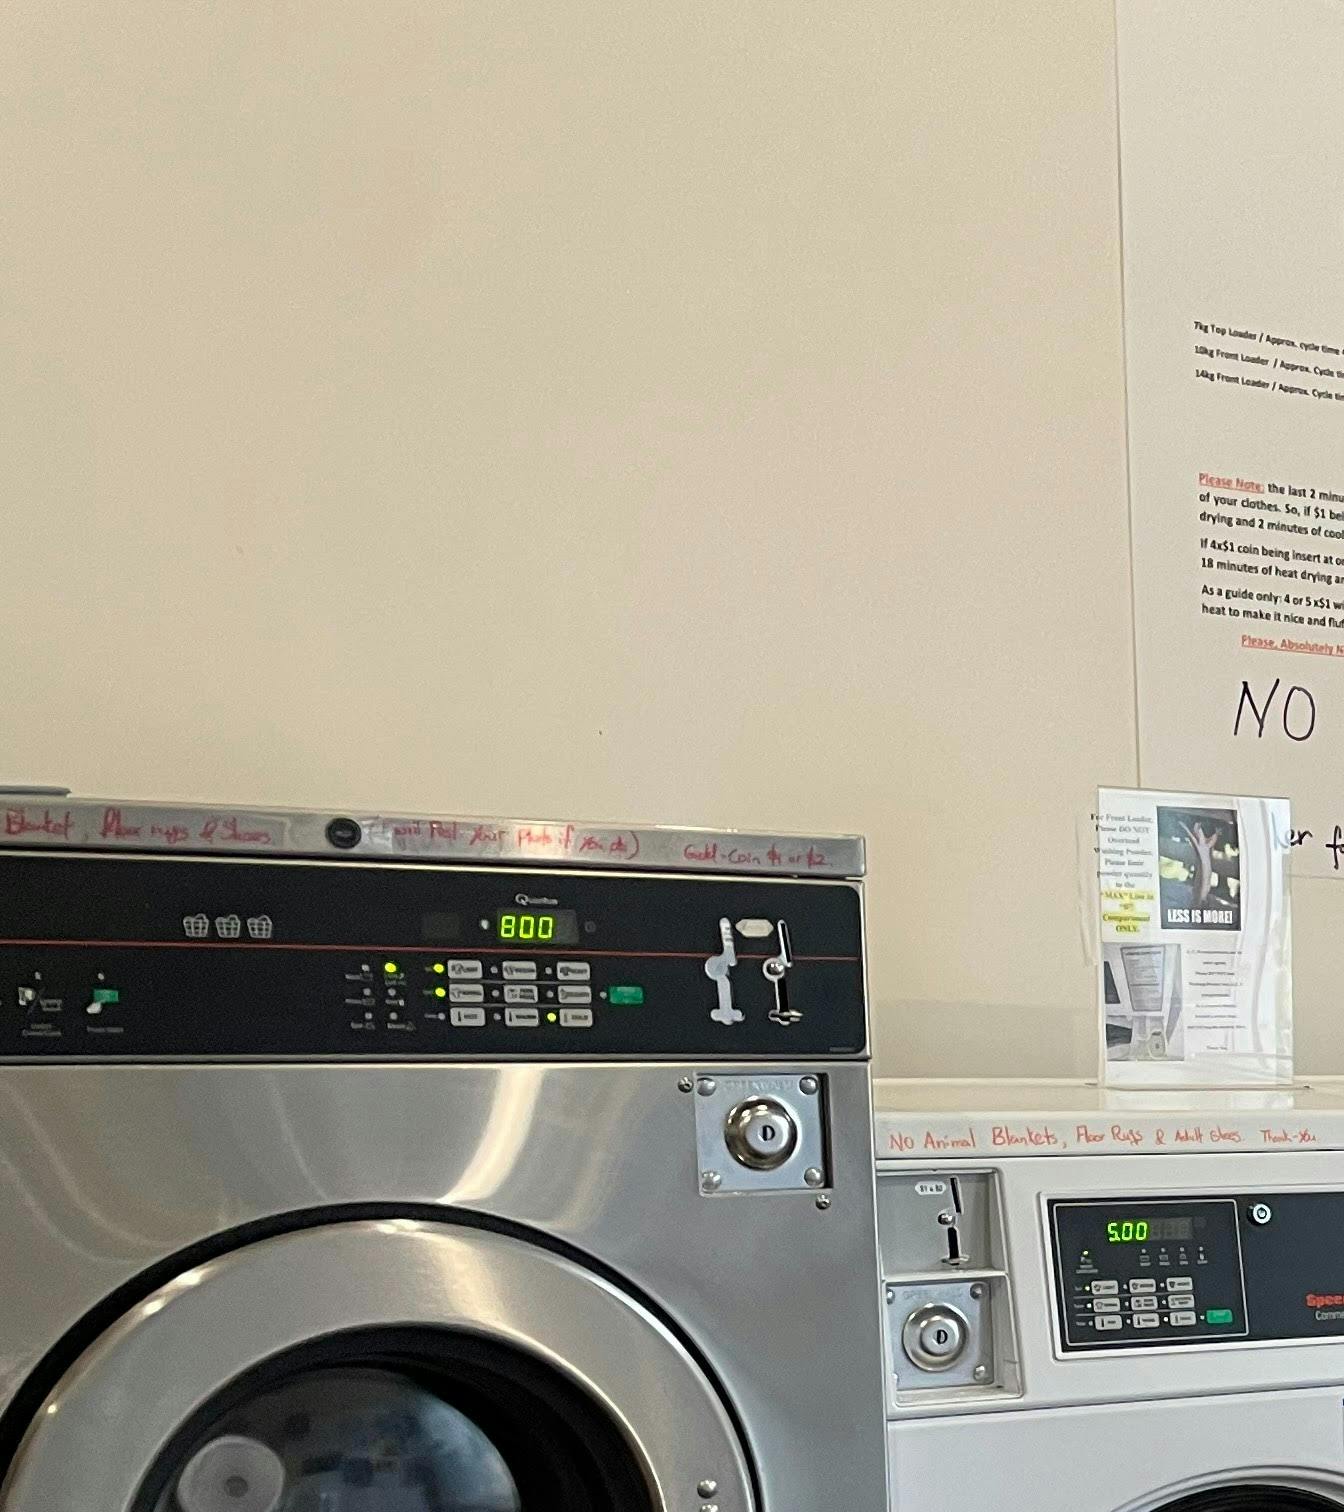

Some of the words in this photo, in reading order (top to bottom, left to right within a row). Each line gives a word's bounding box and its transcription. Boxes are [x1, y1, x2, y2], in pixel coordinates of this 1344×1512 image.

[1199, 472, 1234, 491] Please
[1268, 482, 1285, 495] the
[1288, 484, 1306, 498] last
[1310, 488, 1315, 500] 2
[1199, 491, 1210, 503] of
[1213, 495, 1237, 508] your
[1285, 503, 1300, 518] So,
[1303, 505, 1311, 517] if
[1314, 506, 1326, 520] $1
[1200, 510, 1233, 528] drying
[1236, 517, 1255, 528] and
[1258, 518, 1264, 530] 2
[1267, 520, 1308, 536] minutes
[1311, 525, 1321, 537] of
[1202, 557, 1213, 569] 18
[1217, 559, 1258, 575] minutes
[1261, 564, 1272, 576] of
[1275, 565, 1298, 580] heat
[1301, 569, 1332, 586] drying
[1202, 583, 1214, 596] As
[1217, 587, 1222, 597] a
[1225, 587, 1254, 601] guide
[1284, 593, 1290, 604] 4
[1293, 596, 1303, 606] or
[1314, 596, 1330, 610] x$1
[1202, 602, 1226, 616] heat
[1229, 606, 1240, 618] to
[1243, 608, 1271, 621] make
[1274, 611, 1281, 622] it
[1284, 612, 1304, 625] nice
[1307, 615, 1326, 627] and
[1233, 678, 1316, 742] NO
[1167, 908, 1190, 924] LESS
[1191, 909, 1201, 924] IS
[924, 1128, 976, 1149] Animal
